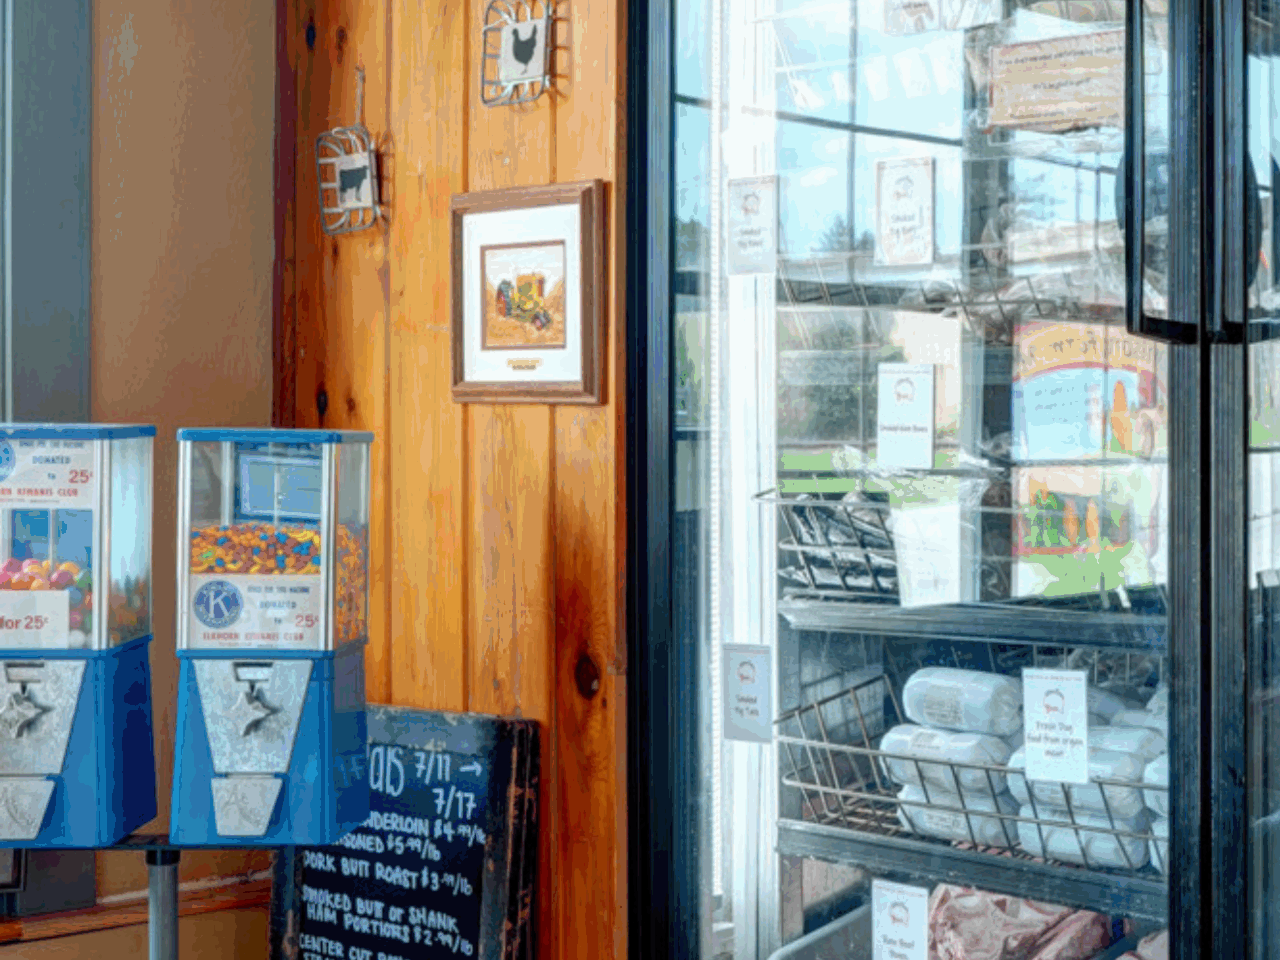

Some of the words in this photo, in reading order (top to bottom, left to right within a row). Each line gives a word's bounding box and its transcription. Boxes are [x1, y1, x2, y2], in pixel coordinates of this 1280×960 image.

[32, 455, 71, 464] DONATED
[0, 615, 22, 630] for
[432, 785, 477, 820] 7/17
[303, 851, 336, 872] PORK
[341, 856, 370, 878] BUTT
[375, 861, 419, 890] ROAST
[302, 884, 351, 912] SMOKED
[408, 906, 460, 934] SHANK
[307, 902, 338, 925] HAM
[343, 913, 410, 943] PORTIONS
[299, 933, 344, 958] CENTER
